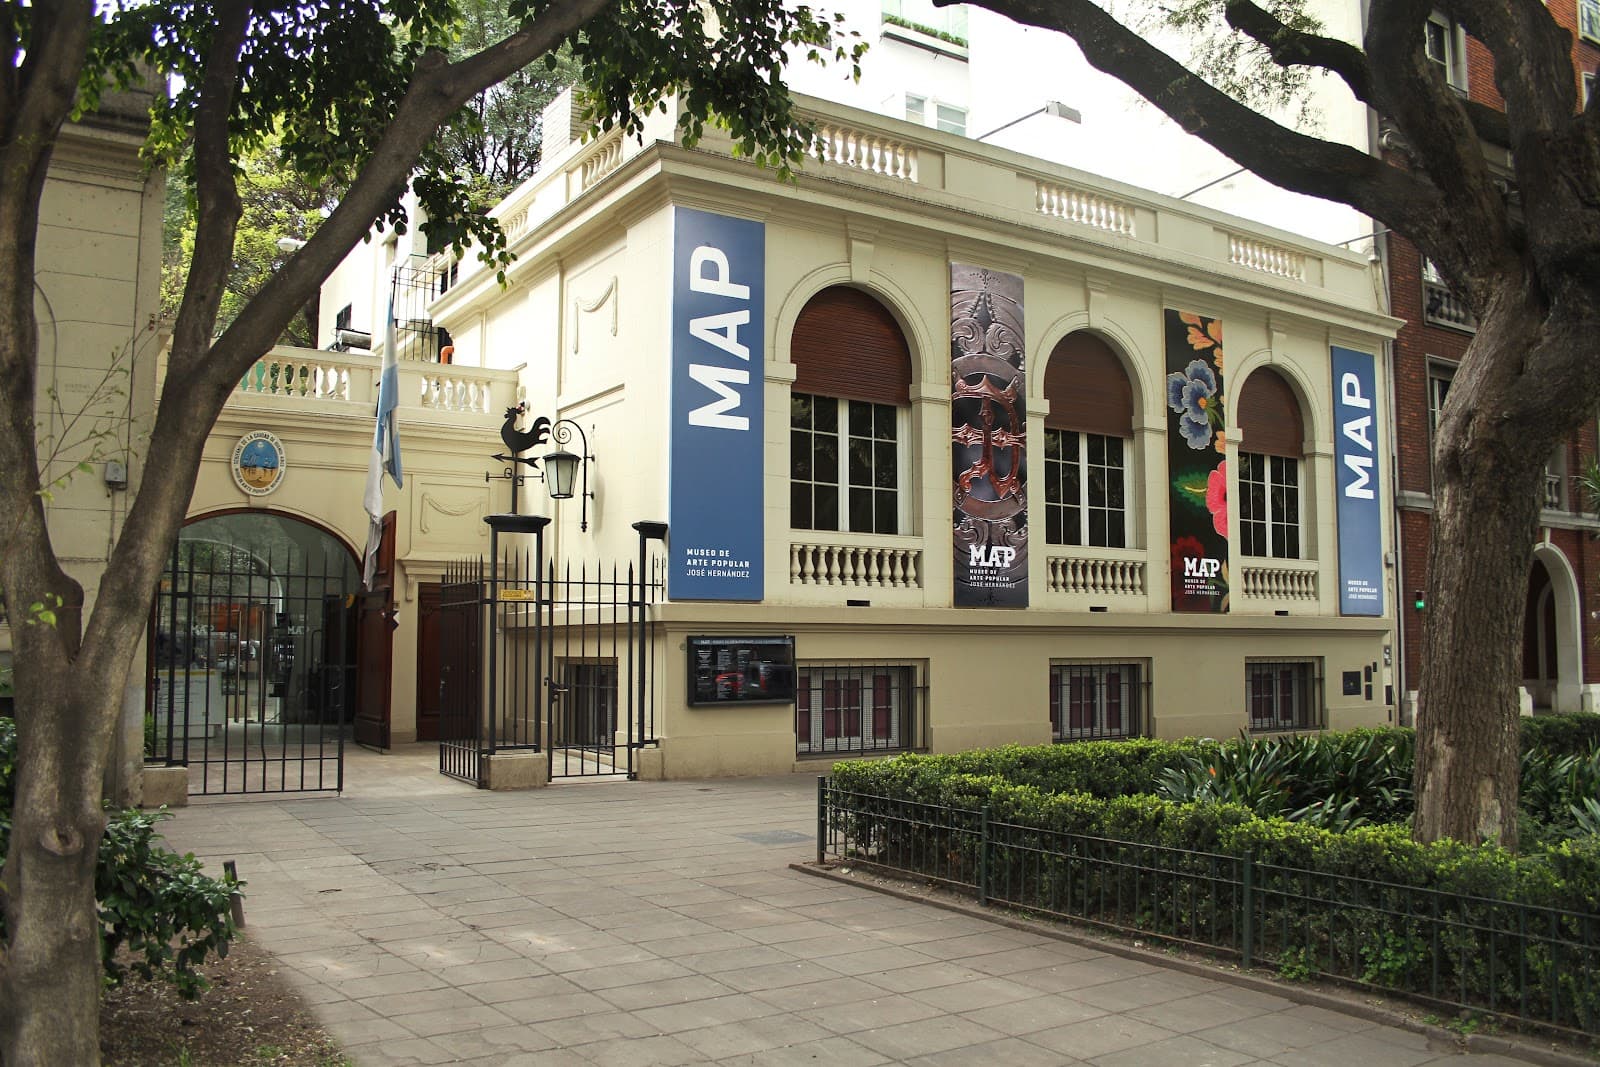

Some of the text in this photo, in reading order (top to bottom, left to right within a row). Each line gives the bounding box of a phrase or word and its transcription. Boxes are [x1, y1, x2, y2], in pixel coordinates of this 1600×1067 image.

[688, 244, 750, 431] MAP
[1341, 372, 1375, 500] MAP
[686, 548, 730, 557] MUSEO DE
[686, 558, 750, 568] ARTE POPULAR
[969, 544, 1016, 568] MAP
[686, 568, 750, 578] JOSÉ HERNÁNDEZ
[1183, 556, 1220, 578] MAP
